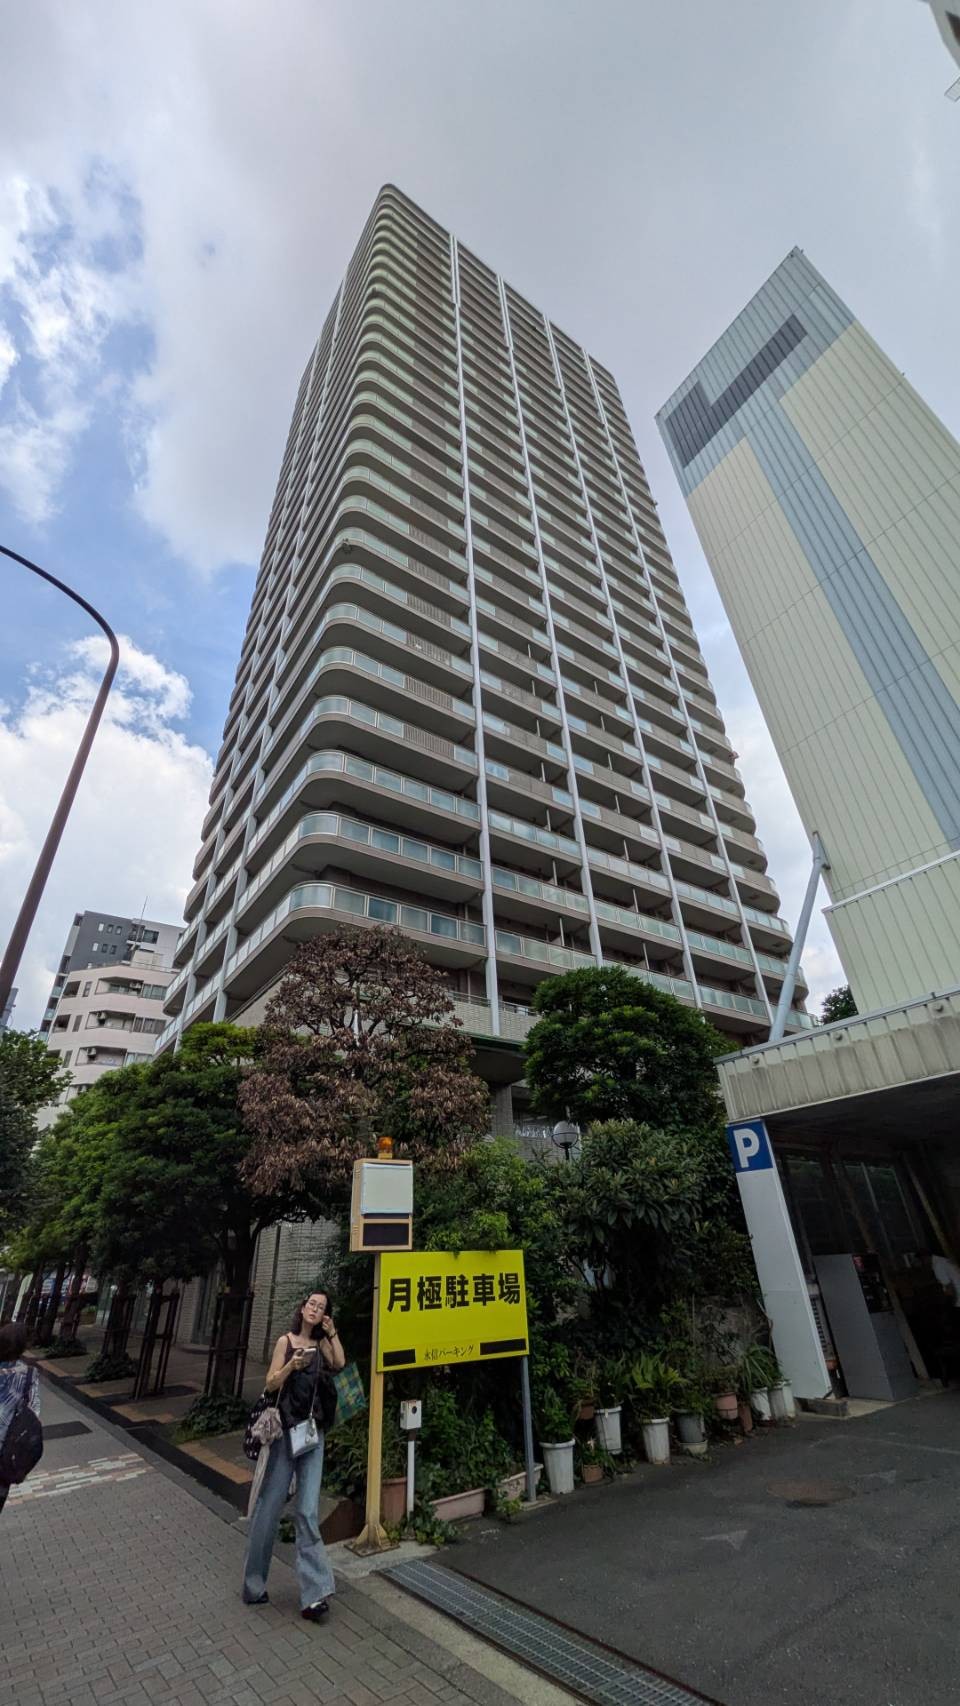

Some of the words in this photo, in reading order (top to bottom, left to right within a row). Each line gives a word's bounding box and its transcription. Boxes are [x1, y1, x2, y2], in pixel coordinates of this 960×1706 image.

[733, 1128, 760, 1168] P
[387, 1272, 521, 1312] 月極駐車場
